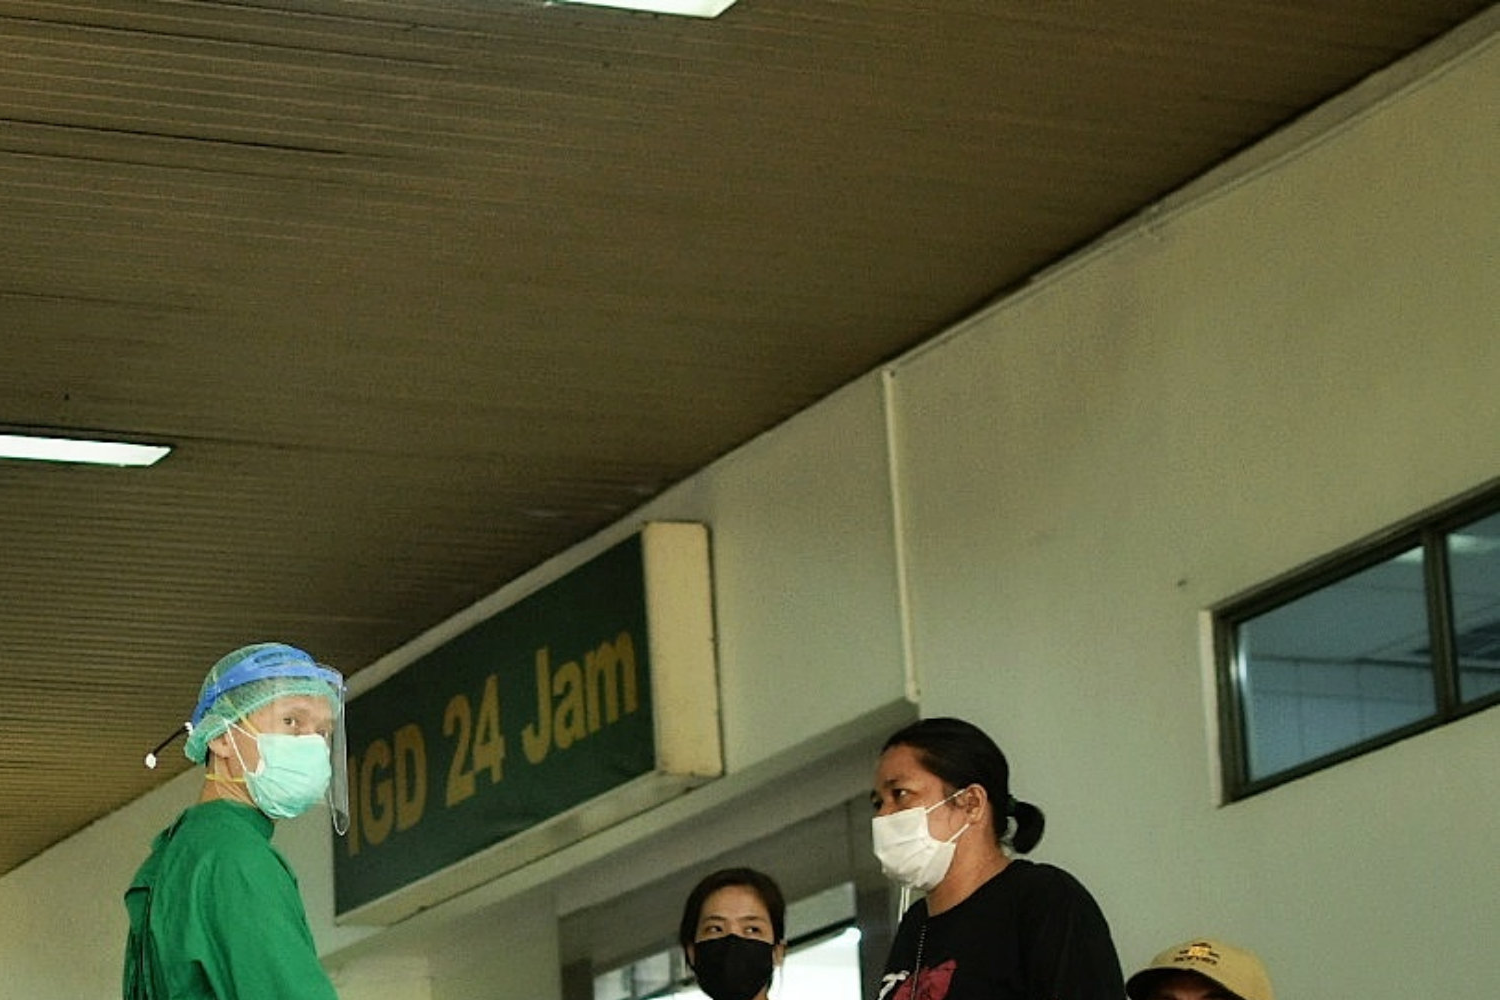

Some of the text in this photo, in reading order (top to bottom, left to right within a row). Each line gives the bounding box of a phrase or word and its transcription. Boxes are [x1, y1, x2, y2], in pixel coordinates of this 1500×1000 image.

[347, 631, 638, 857] IGD 24 Jam
